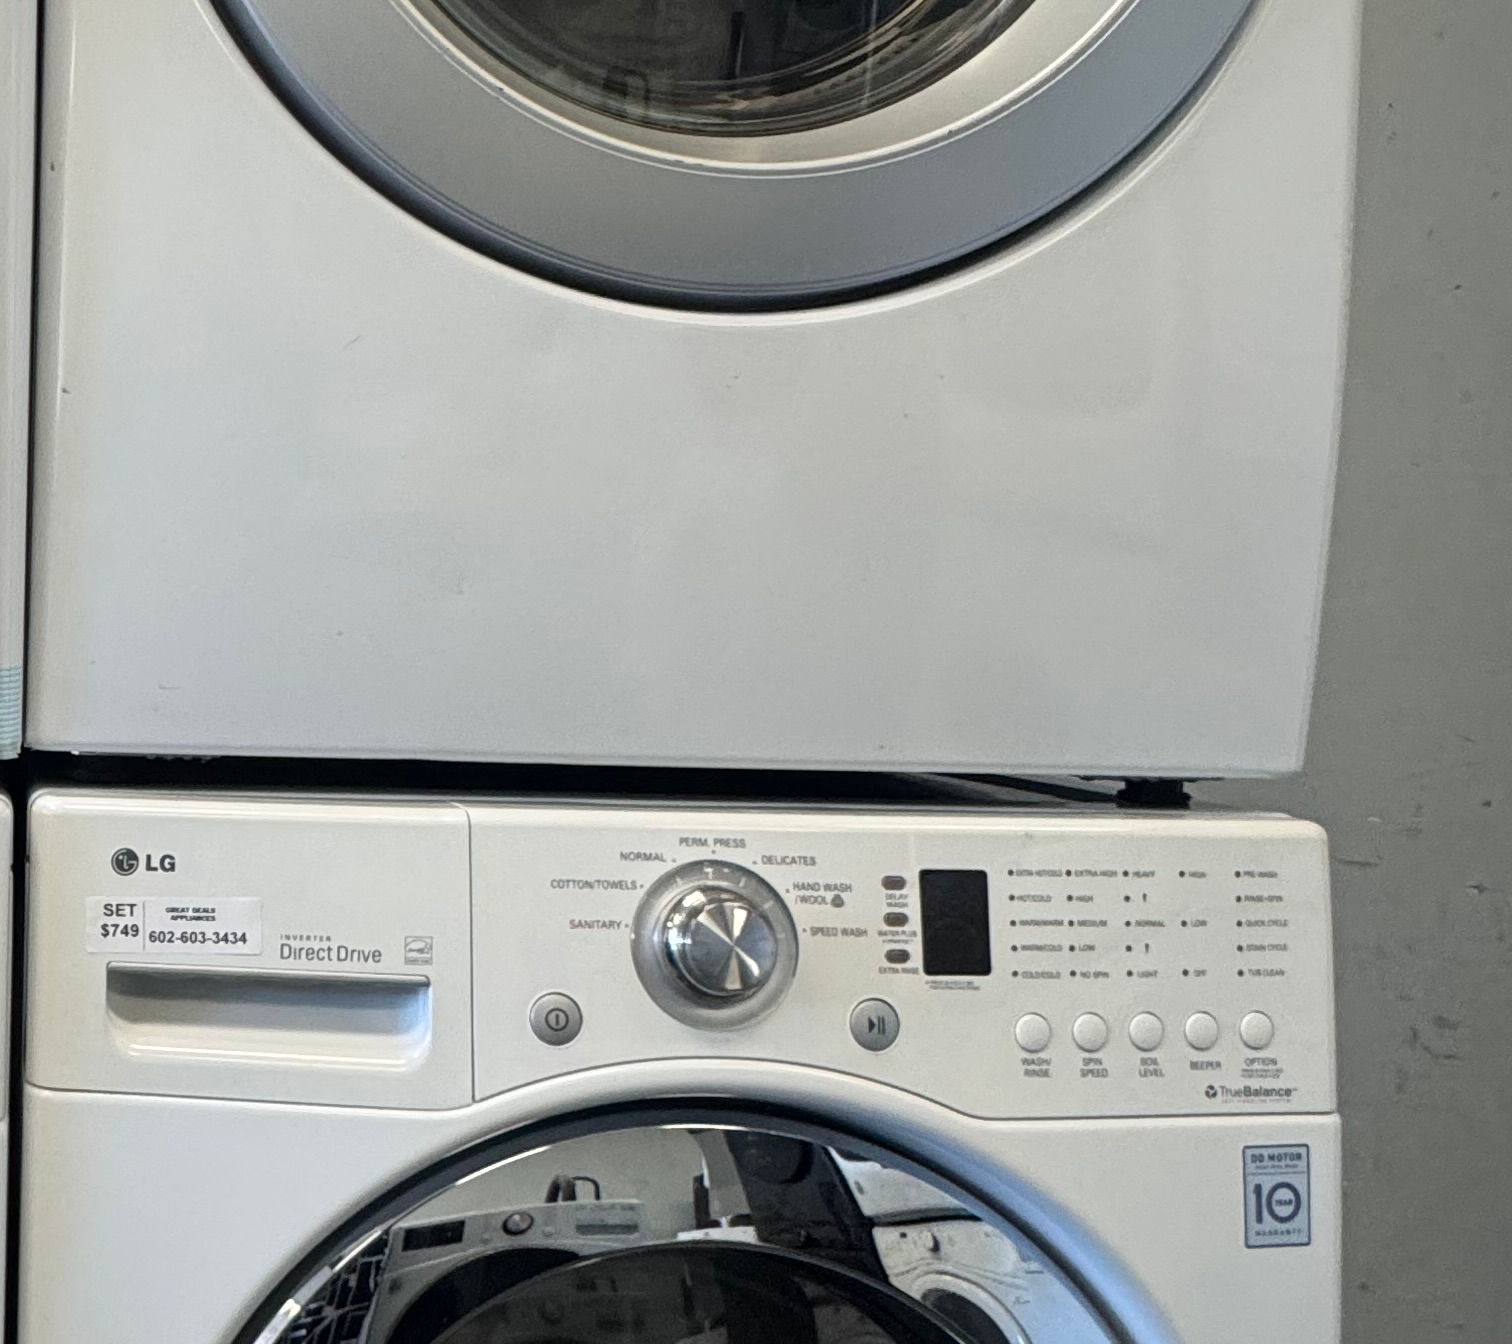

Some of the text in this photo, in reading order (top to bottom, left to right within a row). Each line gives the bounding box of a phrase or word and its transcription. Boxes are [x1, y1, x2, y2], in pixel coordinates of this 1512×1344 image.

[713, 837, 747, 849] PRESS
[619, 851, 667, 863] NORMAL
[761, 854, 817, 867] DELICATES
[145, 854, 177, 873] LG
[550, 878, 638, 890] COTTON/TOWELS
[792, 881, 853, 894] HAND WASH
[793, 894, 829, 906] /WOOL
[885, 893, 909, 901] DELAY
[103, 903, 138, 918] SET
[165, 907, 216, 915] GREAT DEALS
[170, 914, 216, 922] APPLIANCES
[569, 919, 622, 930] SANITARY
[100, 923, 140, 939] $749
[809, 926, 869, 938] SPEED WASH
[148, 930, 248, 945] 602-603-3434
[279, 934, 332, 942] INVERTER
[279, 943, 383, 964] Direct Drive
[1082, 1056, 1103, 1067] SPIN
[1139, 1056, 1161, 1067] SOIL
[1189, 1060, 1223, 1071] BEEPER
[1243, 1057, 1279, 1067] OPTION
[1023, 1067, 1051, 1078] RINSE
[1079, 1067, 1109, 1078] SPEED
[1138, 1067, 1166, 1078] LEVEL
[1267, 1152, 1303, 1163] MOTOR
[1252, 1181, 1302, 1225] 10
